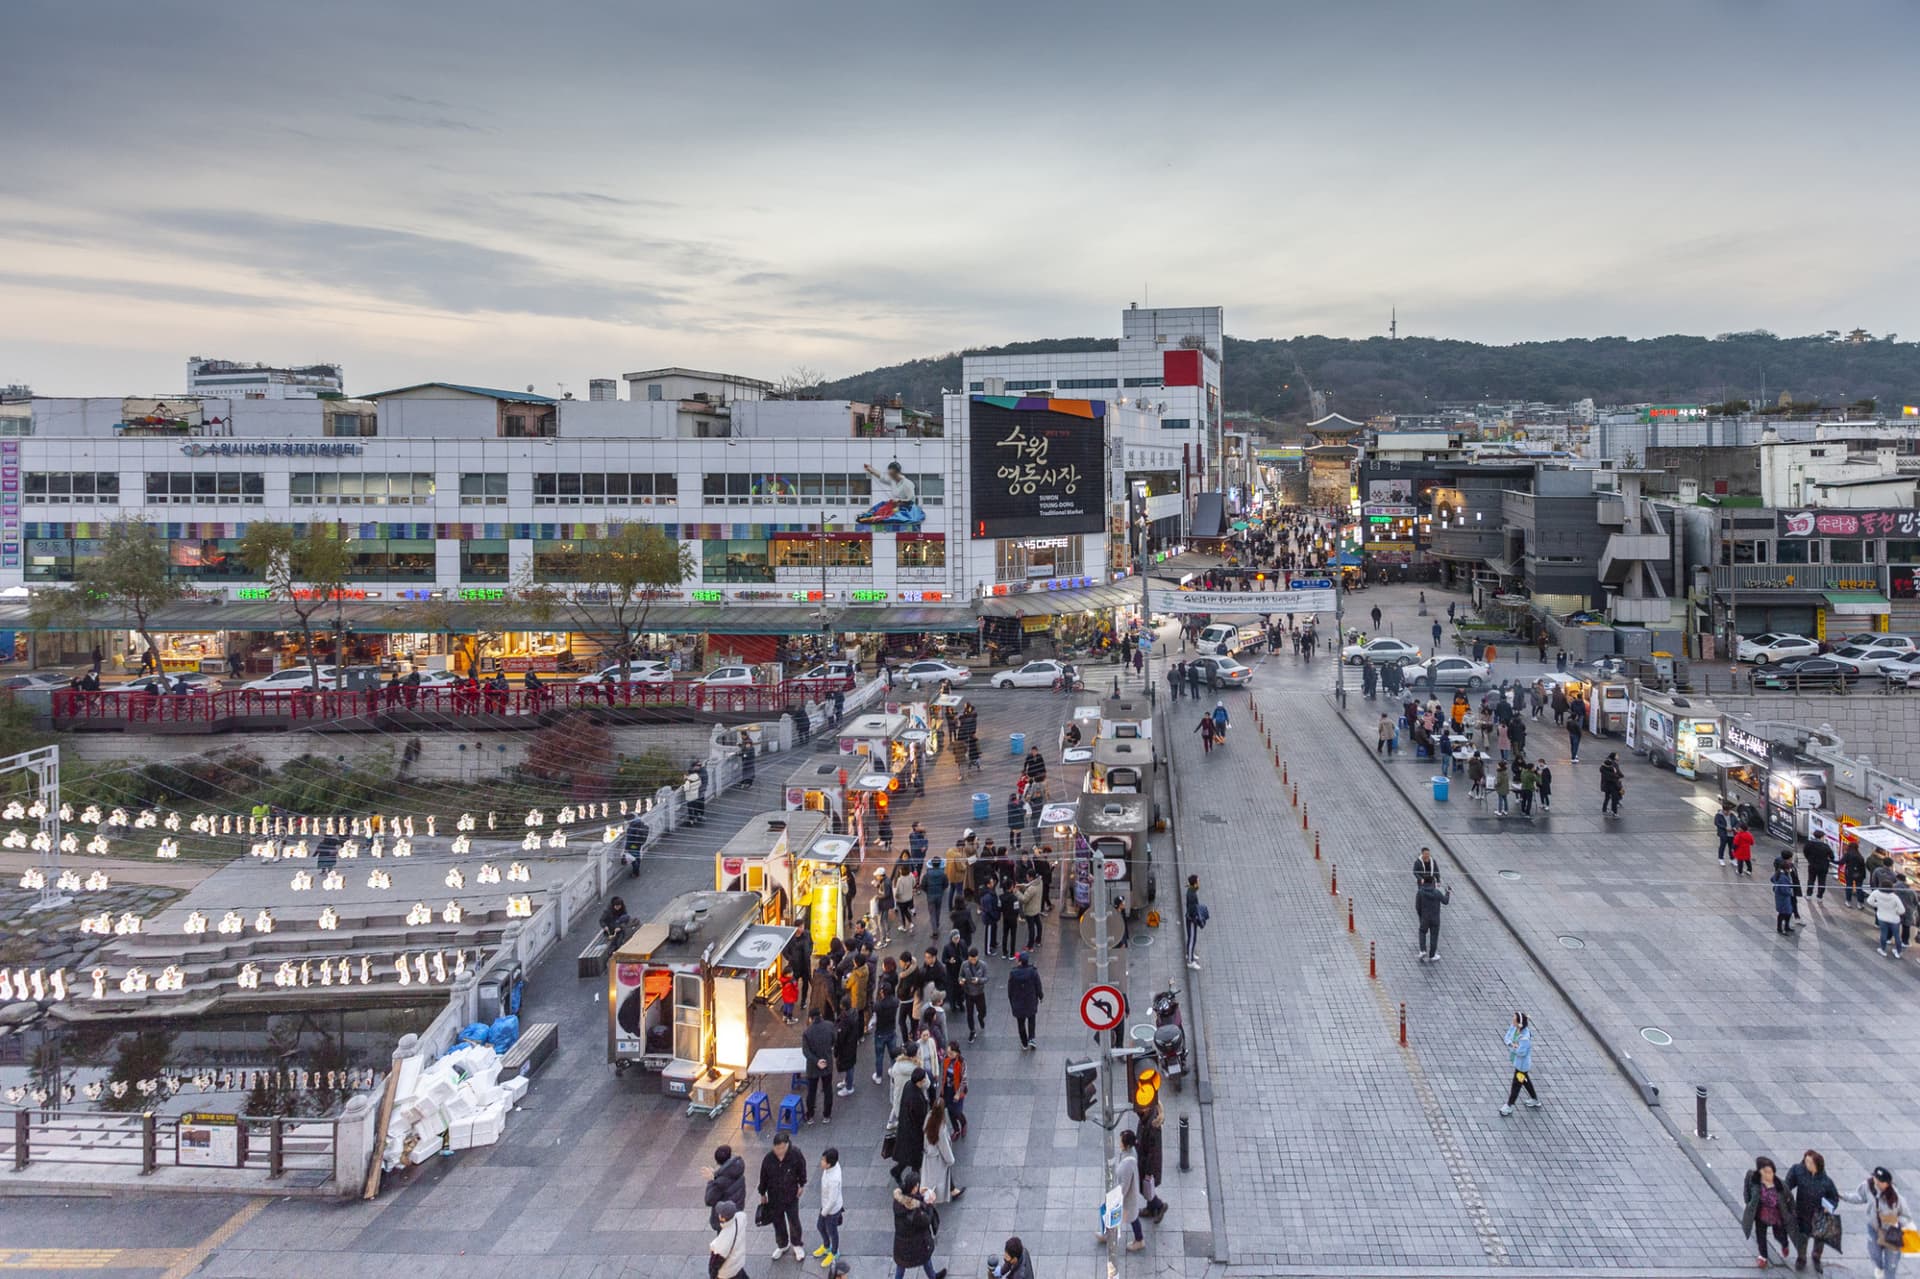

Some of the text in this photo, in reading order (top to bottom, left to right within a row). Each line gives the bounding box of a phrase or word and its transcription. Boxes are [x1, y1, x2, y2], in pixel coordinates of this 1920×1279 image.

[996, 425, 1049, 465] 수원
[997, 463, 1082, 495] 영동시장
[1818, 516, 1858, 531] 수라상
[1861, 512, 1895, 535] 풍천
[1036, 538, 1068, 549] COFFEE
